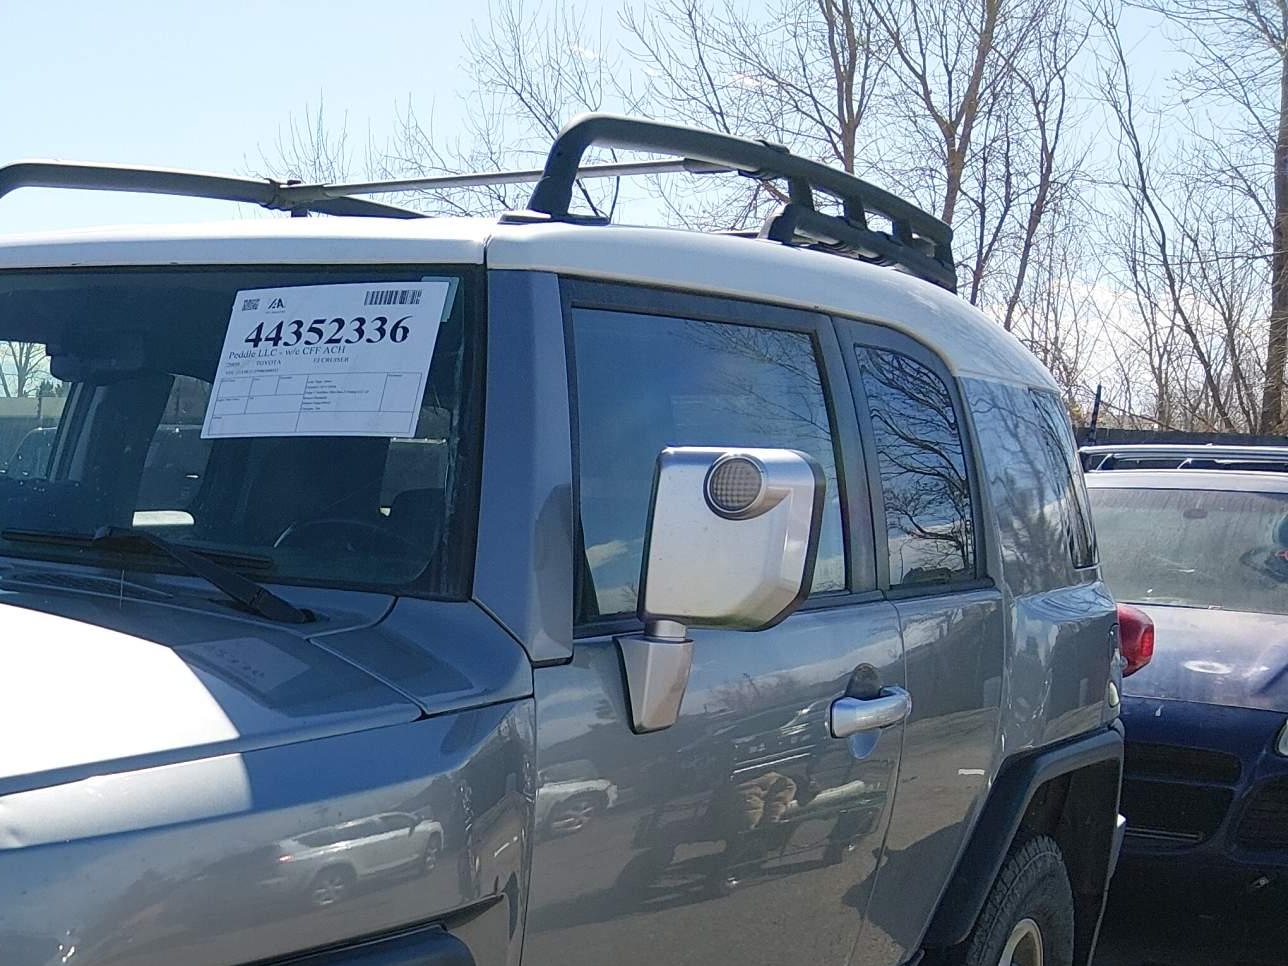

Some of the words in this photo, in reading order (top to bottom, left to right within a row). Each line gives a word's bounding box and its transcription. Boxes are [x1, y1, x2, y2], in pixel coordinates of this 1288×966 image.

[245, 314, 415, 348] 44352336
[228, 348, 256, 359] Peddle
[257, 347, 278, 357] LLC
[302, 345, 321, 355] CFF
[323, 344, 346, 354] ACH
